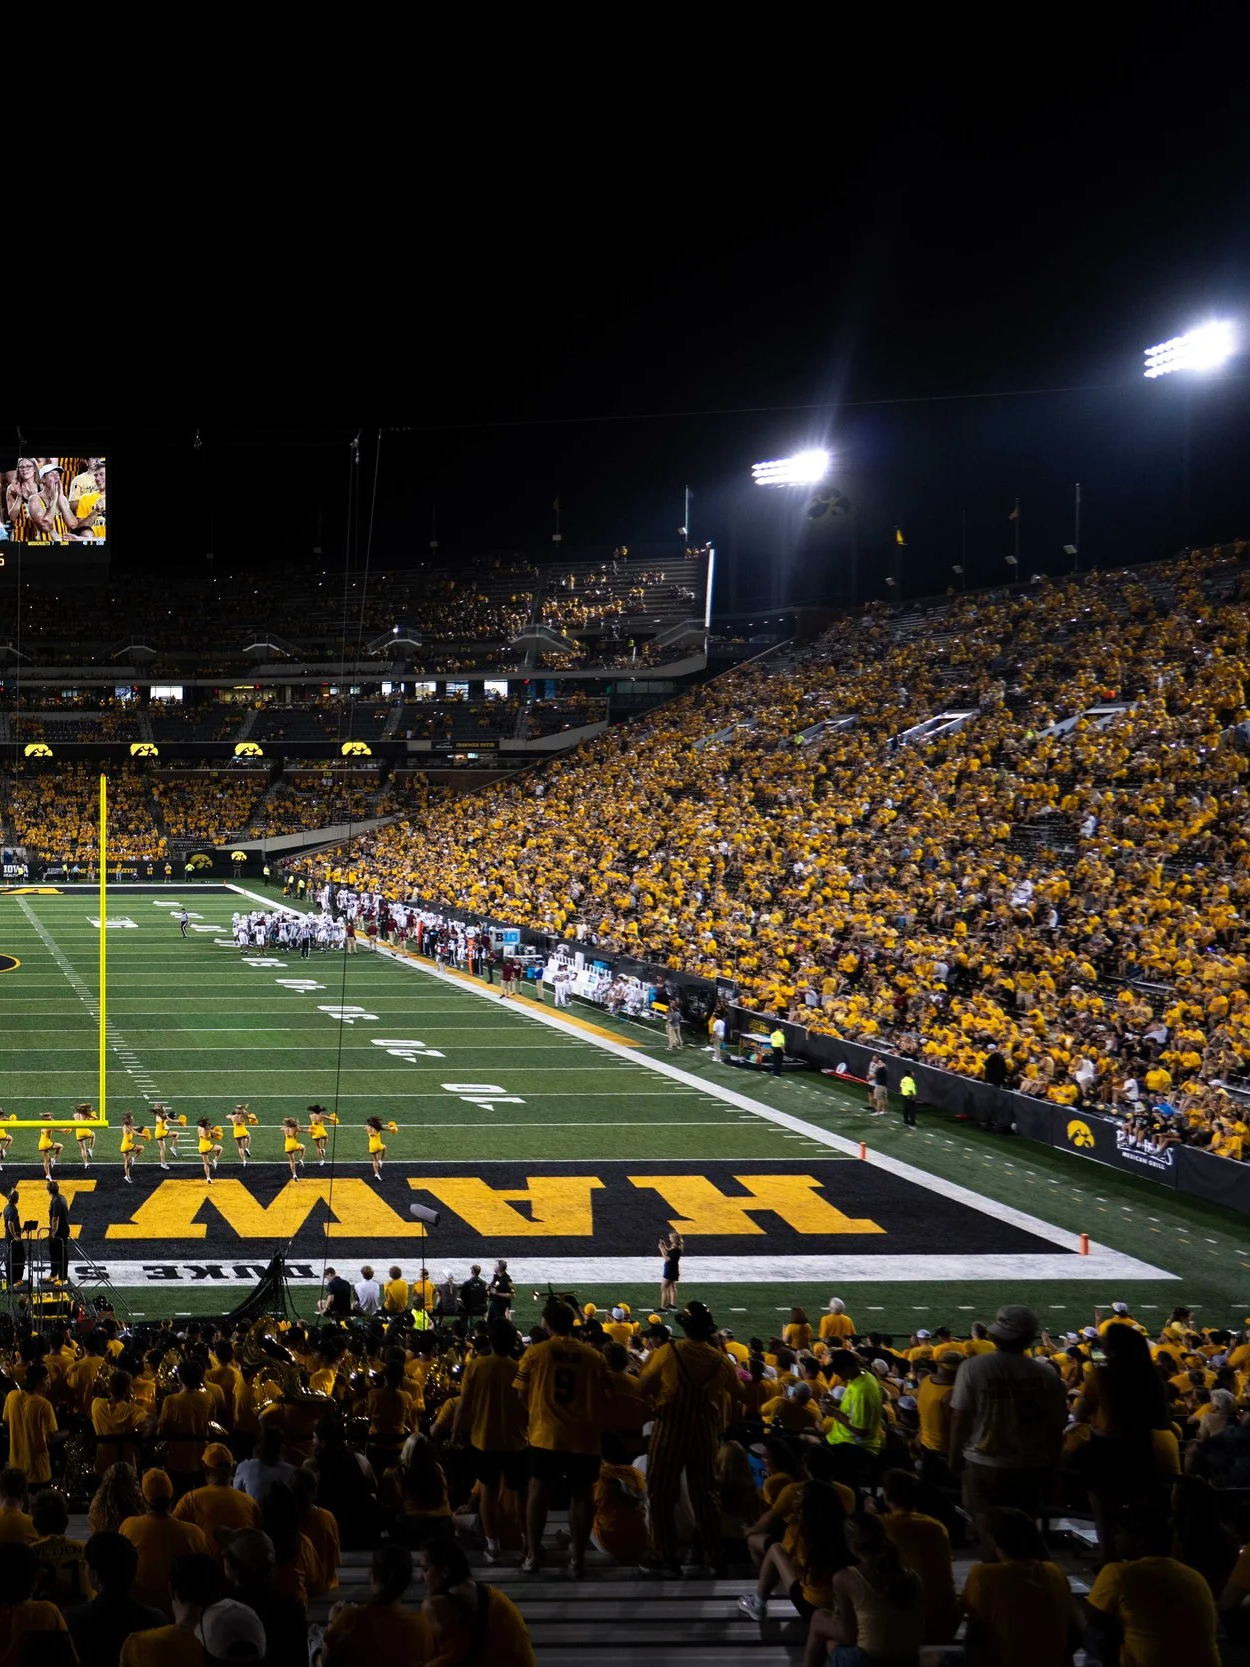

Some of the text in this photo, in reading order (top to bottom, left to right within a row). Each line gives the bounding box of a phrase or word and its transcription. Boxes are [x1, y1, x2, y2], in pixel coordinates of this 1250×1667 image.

[370, 1039, 447, 1058] 20
[440, 1083, 527, 1104] 10
[1121, 1151, 1166, 1170] MEXICAN GRILL
[142, 1264, 321, 1281] DUKE
[555, 1368, 576, 1404] 9
